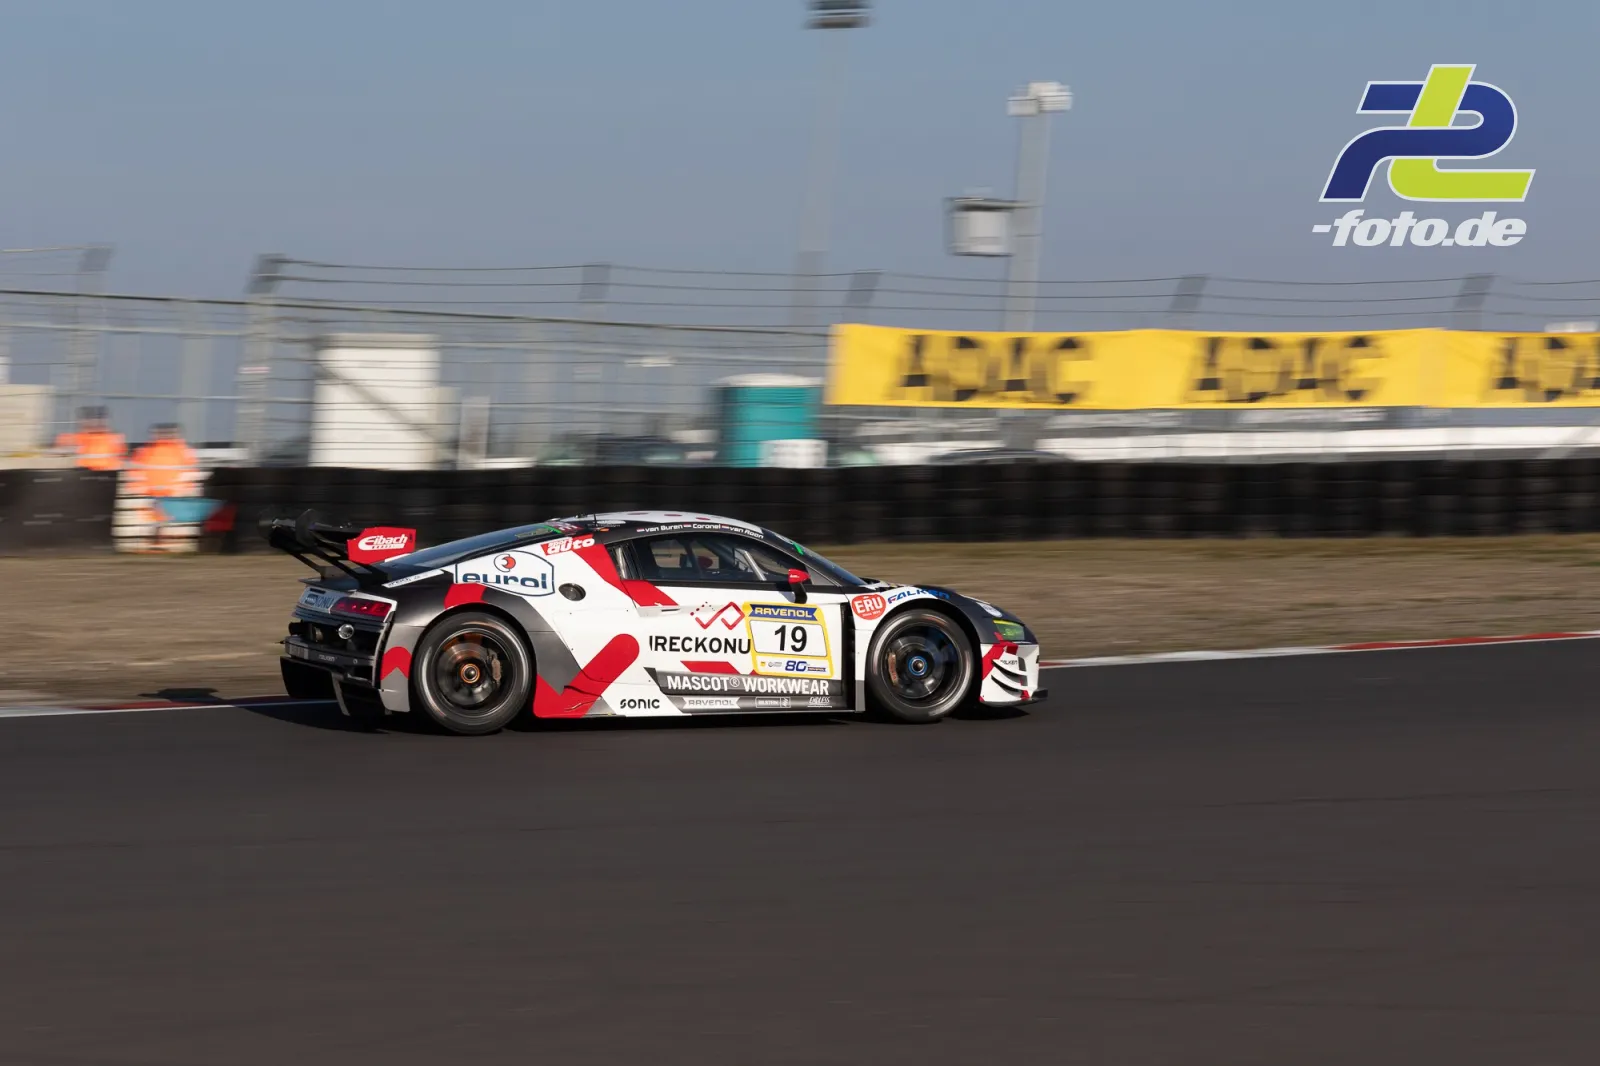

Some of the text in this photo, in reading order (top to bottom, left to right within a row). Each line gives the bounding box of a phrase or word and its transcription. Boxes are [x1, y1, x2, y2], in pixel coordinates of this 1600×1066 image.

[358, 533, 408, 551] Eibach
[547, 537, 595, 555] auto
[462, 572, 547, 589] eurol
[888, 589, 950, 604] FALKEN
[754, 607, 813, 618] RAVENOL
[774, 624, 808, 653] 19
[742, 677, 829, 695] WORKWEAR
